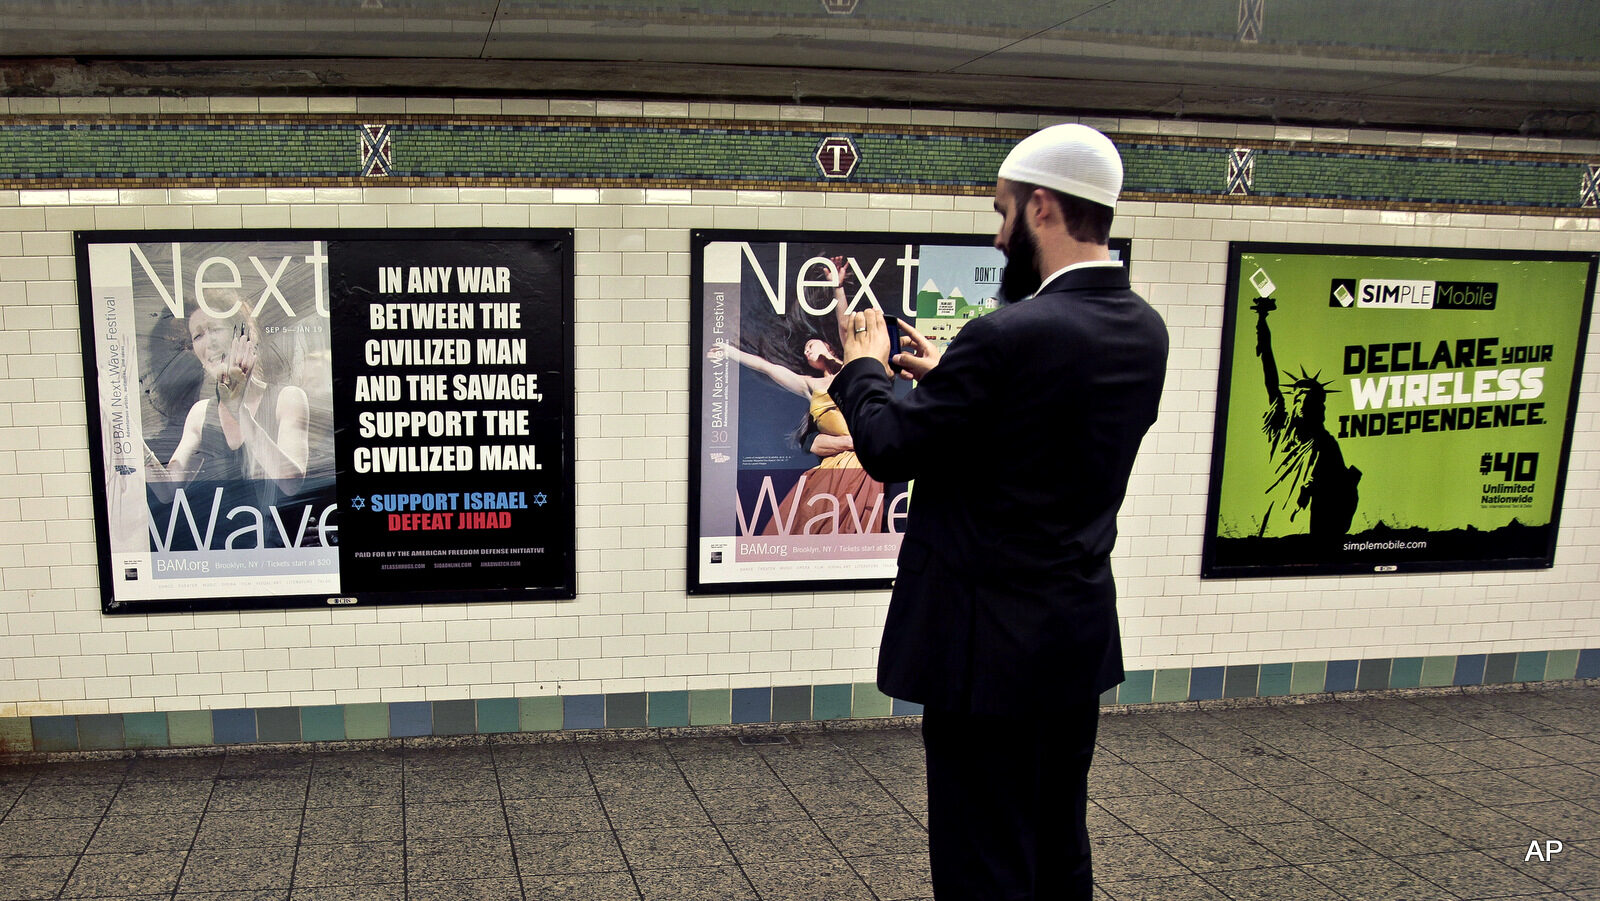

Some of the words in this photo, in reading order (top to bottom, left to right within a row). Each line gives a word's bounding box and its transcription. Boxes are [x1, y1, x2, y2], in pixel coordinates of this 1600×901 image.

[827, 146, 848, 172] T
[129, 241, 328, 318] Next
[378, 267, 403, 294] IN
[408, 267, 453, 293] ANY
[457, 267, 511, 293] WAR
[741, 242, 919, 316] Next
[975, 267, 996, 282] DON'T
[1362, 284, 1432, 304] SIMPLE
[1436, 286, 1493, 305] Mobile
[104, 296, 117, 341] Festival
[370, 303, 475, 330] BETWEEN
[480, 303, 521, 329] THE
[712, 292, 724, 334] Festival
[108, 344, 120, 376] Wave
[365, 339, 472, 366] CIVILIZED
[477, 339, 526, 365] MAN
[1343, 338, 1499, 375] DECLARE
[110, 380, 122, 407] Next
[355, 375, 402, 401] AND
[406, 375, 448, 401] THE
[453, 374, 542, 402] SAVAGE,
[712, 372, 723, 398] Next
[1350, 367, 1545, 410] WIRELESS
[112, 412, 124, 439] BAM
[359, 410, 478, 437] SUPPORT
[483, 410, 529, 436] THE
[712, 402, 723, 428] BAM
[1338, 403, 1547, 438] INDEPENDENCE.
[712, 430, 728, 442] 30
[354, 446, 473, 473] CIVILIZED
[479, 445, 542, 471] MAN.
[1480, 452, 1539, 481] $40
[371, 493, 460, 512] SUPPORT
[464, 492, 528, 510] ISRAEL
[1481, 495, 1533, 504] Nationwide
[1482, 484, 1534, 493] Unlimited
[388, 512, 454, 531] DEFEAT
[458, 511, 512, 530] JIHAD
[740, 543, 787, 557] BAM.org
[1343, 539, 1427, 552] simplemobile.com
[157, 559, 209, 572] BAM.org
